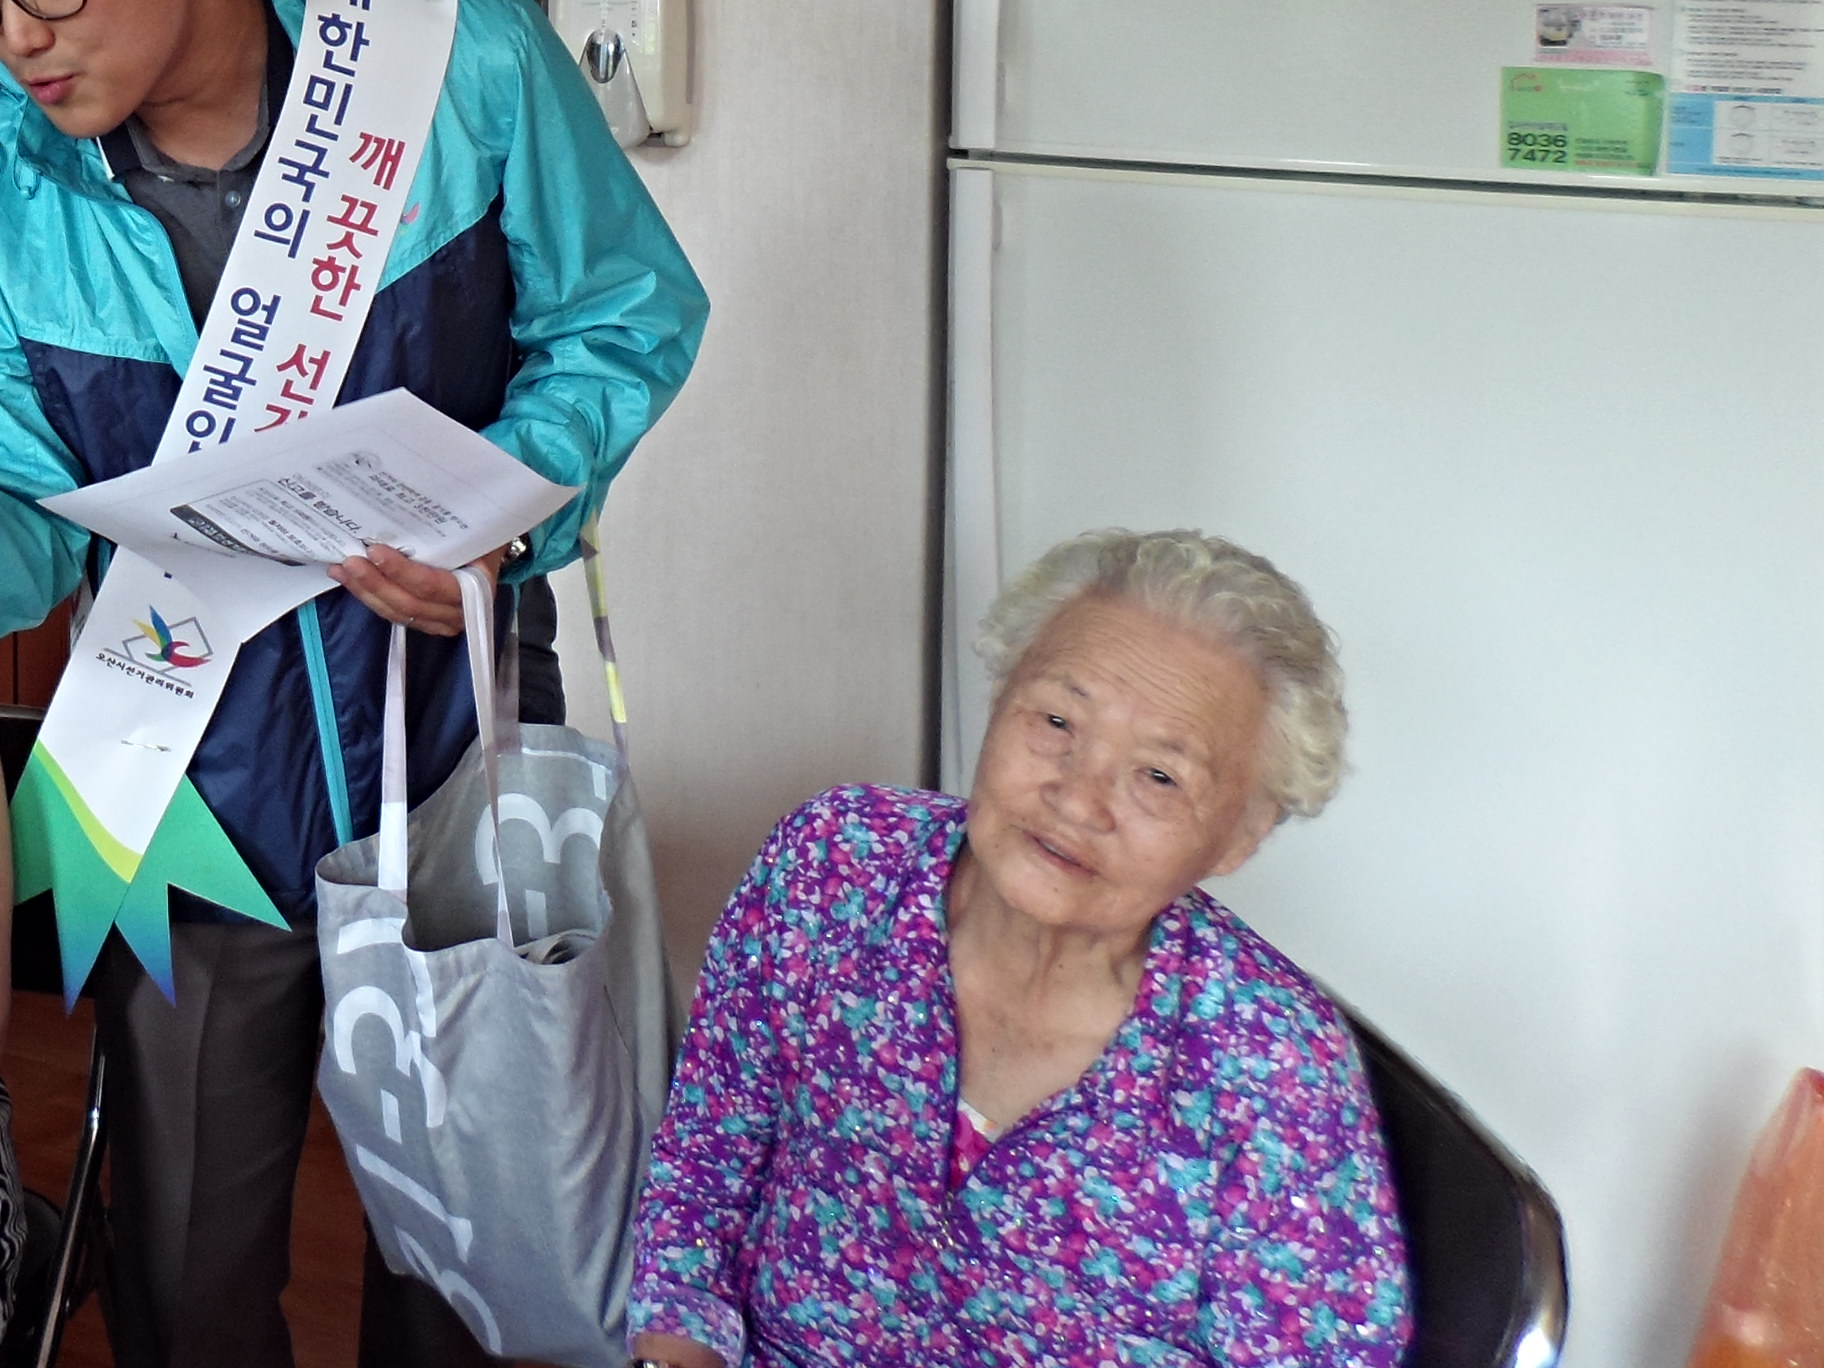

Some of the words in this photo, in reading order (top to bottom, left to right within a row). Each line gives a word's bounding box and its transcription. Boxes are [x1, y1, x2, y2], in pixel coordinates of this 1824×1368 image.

[1507, 132, 1568, 148] 8036
[1507, 147, 1568, 164] 7472
[309, 131, 406, 322] 깨끗한
[95, 652, 194, 699] 오산시선거관리위원회
